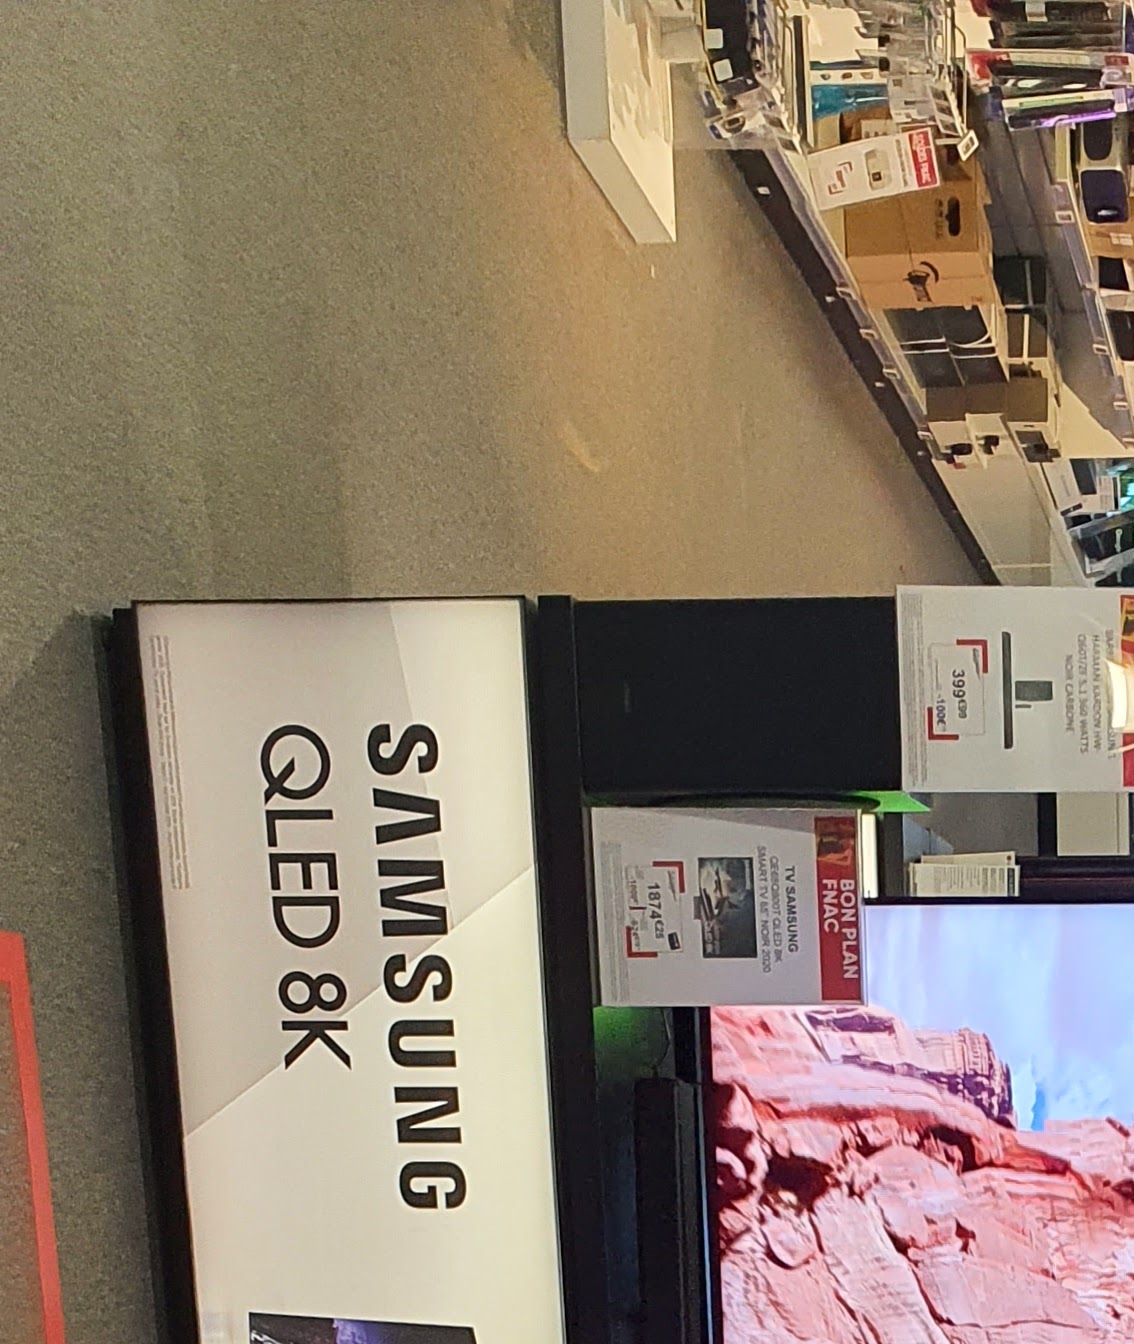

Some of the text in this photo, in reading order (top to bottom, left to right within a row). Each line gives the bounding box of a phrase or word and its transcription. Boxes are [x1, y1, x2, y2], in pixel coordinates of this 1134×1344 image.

[757, 845, 767, 883] SMART
[260, 724, 353, 1071] QLED 8K
[647, 882, 664, 939] 1874€25
[759, 886, 768, 900] TV
[785, 865, 799, 954] TV SAMSUNG
[821, 879, 839, 934] FNAC
[760, 919, 771, 947] NOIR
[839, 879, 858, 980] BON PLAN
[368, 723, 466, 1210] SAMSUNG
[761, 948, 771, 974] 2020
